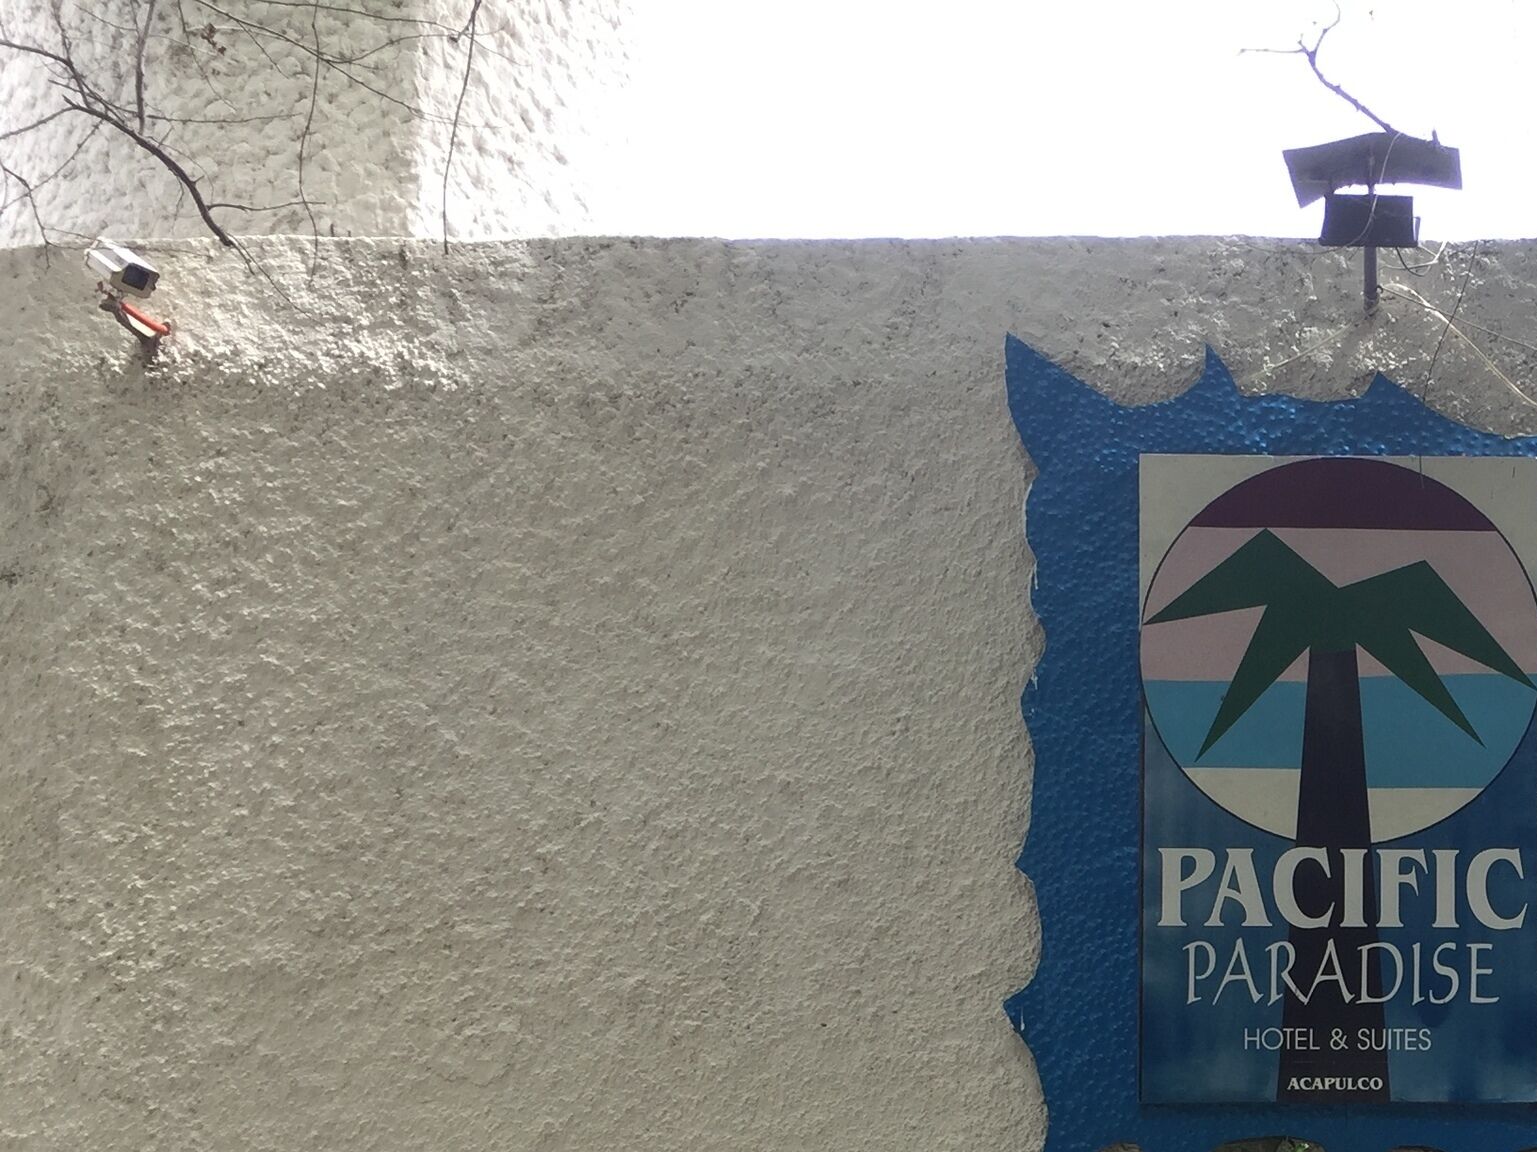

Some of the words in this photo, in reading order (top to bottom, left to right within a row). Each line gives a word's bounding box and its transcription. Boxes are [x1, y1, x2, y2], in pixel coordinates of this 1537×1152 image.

[1156, 846, 1529, 931] PACIFIC
[1182, 936, 1501, 1006] PARADISE
[1244, 1027, 1321, 1052] HOTEL
[1329, 1027, 1348, 1052] &
[1357, 1027, 1432, 1052] SUITES
[1286, 1076, 1384, 1091] ACAPULCO
